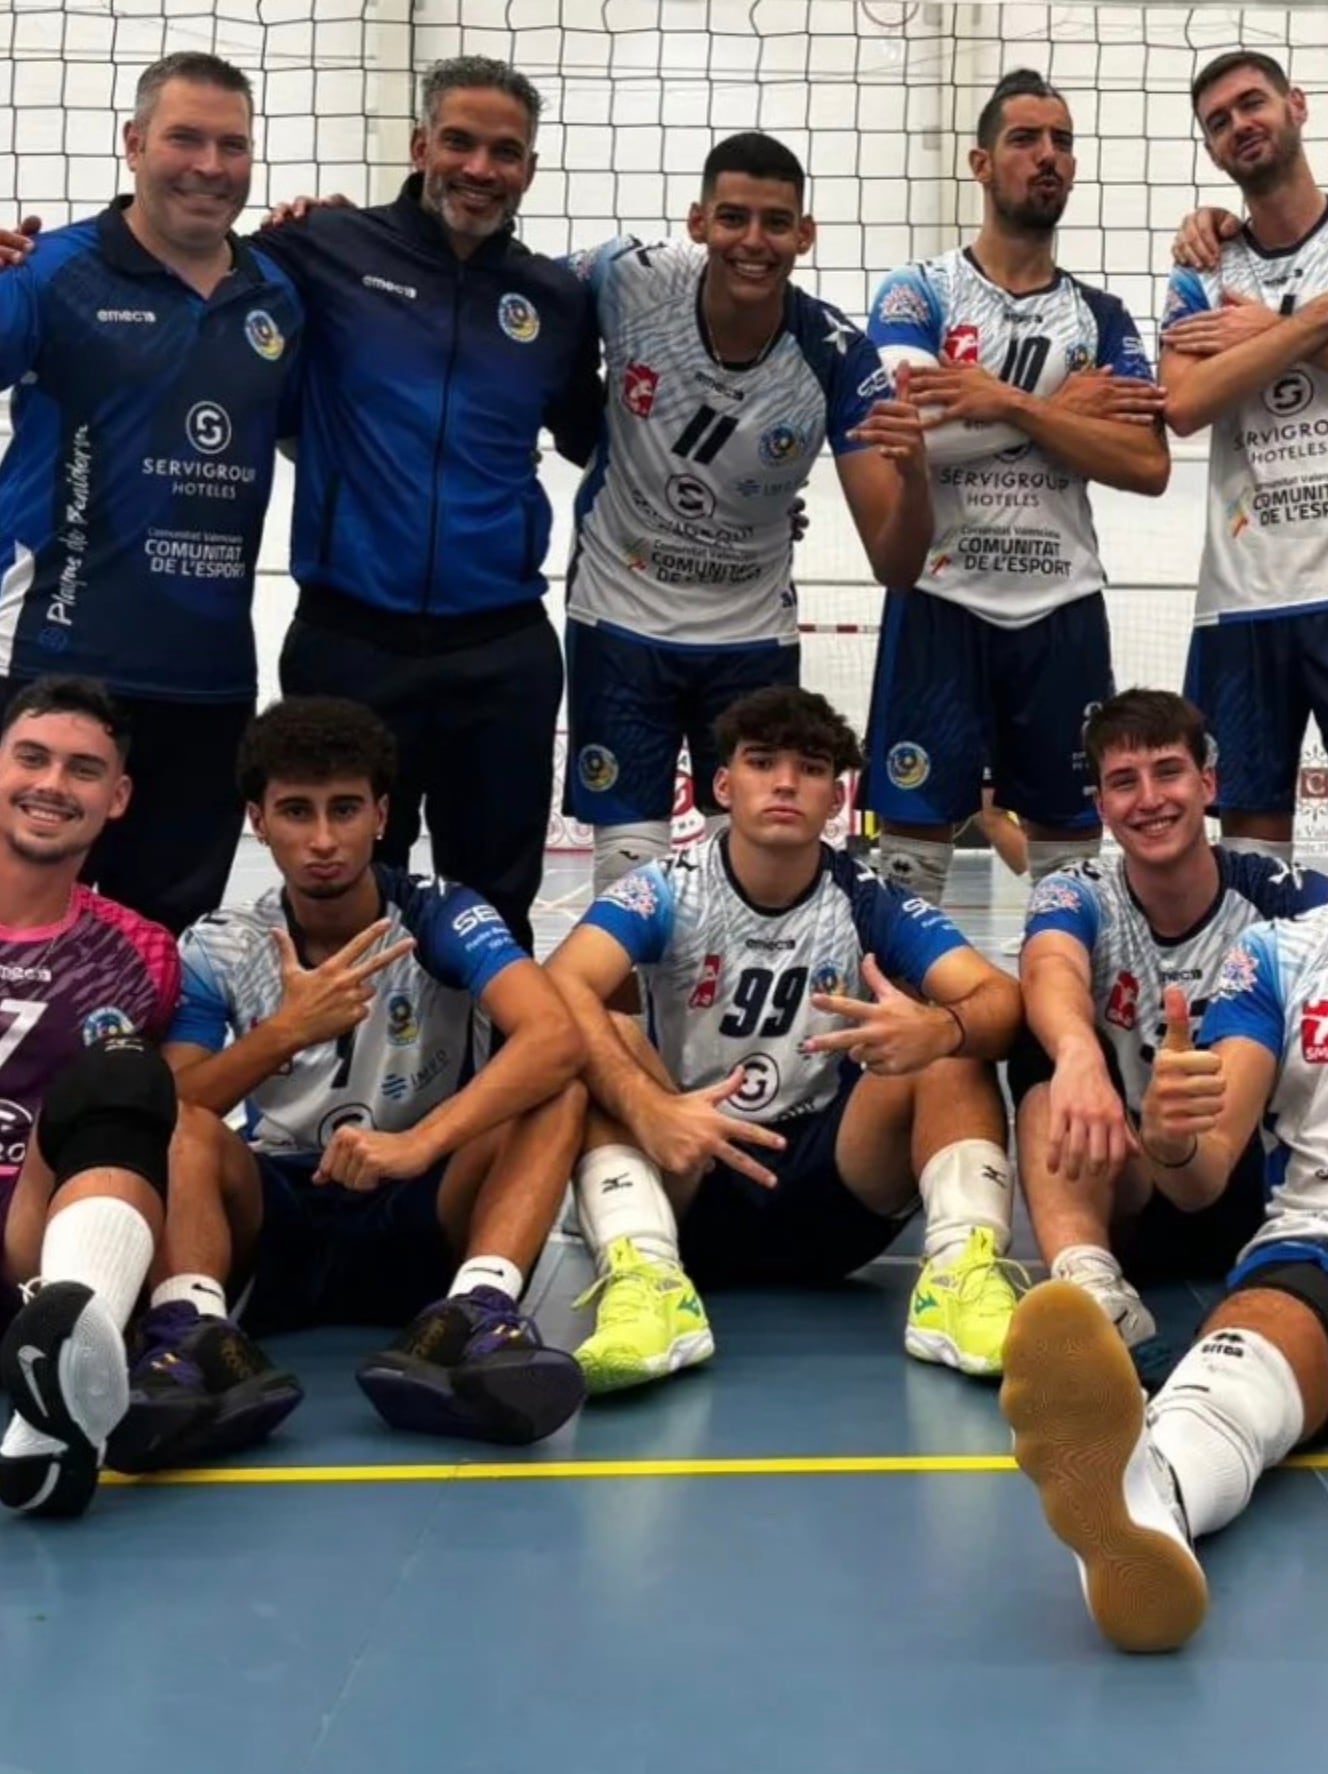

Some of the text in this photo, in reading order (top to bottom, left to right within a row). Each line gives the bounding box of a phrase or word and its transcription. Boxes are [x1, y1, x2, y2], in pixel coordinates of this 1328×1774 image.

[670, 404, 740, 465] 11
[1252, 441, 1328, 465] HOTELES
[172, 480, 236, 500] HOTELES
[966, 493, 1041, 509] HOTELES
[1260, 505, 1281, 526] DE
[144, 538, 242, 562] COMUNITAT
[957, 536, 1061, 558] COMUNITAT
[150, 557, 176, 575] DE
[964, 554, 1072, 579] DE L'ESPORT
[718, 967, 809, 1039] 99
